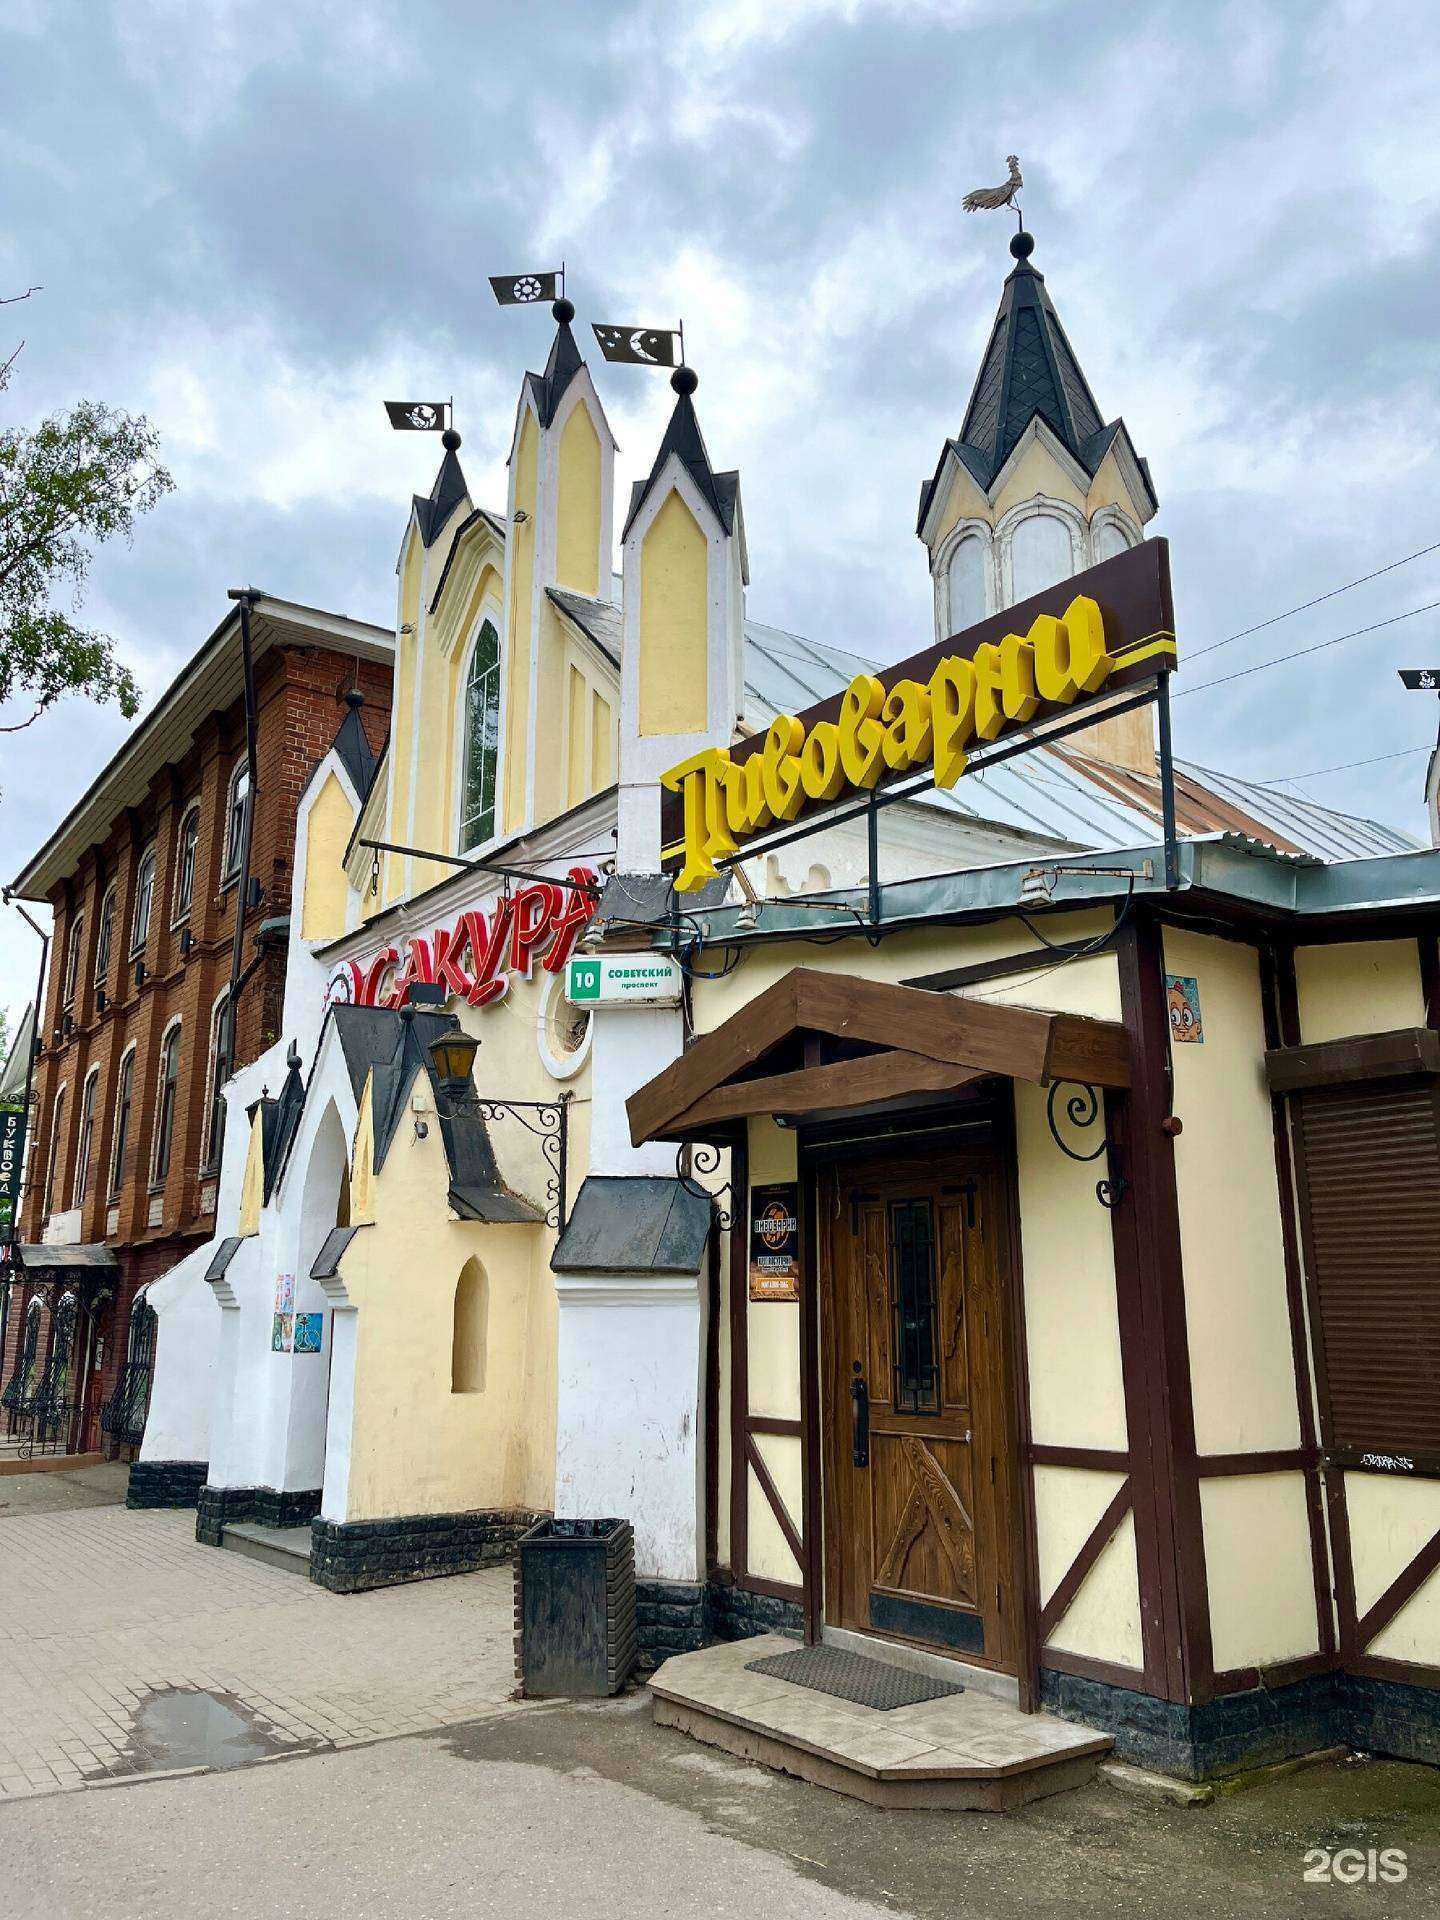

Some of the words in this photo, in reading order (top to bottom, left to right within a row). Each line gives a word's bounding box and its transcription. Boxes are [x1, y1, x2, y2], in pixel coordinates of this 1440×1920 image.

[661, 594, 1115, 892] Пивоварни
[359, 866, 599, 1009] САКУРА
[608, 966, 672, 978] СОВЕТСКИЙ
[575, 973, 595, 988] 10
